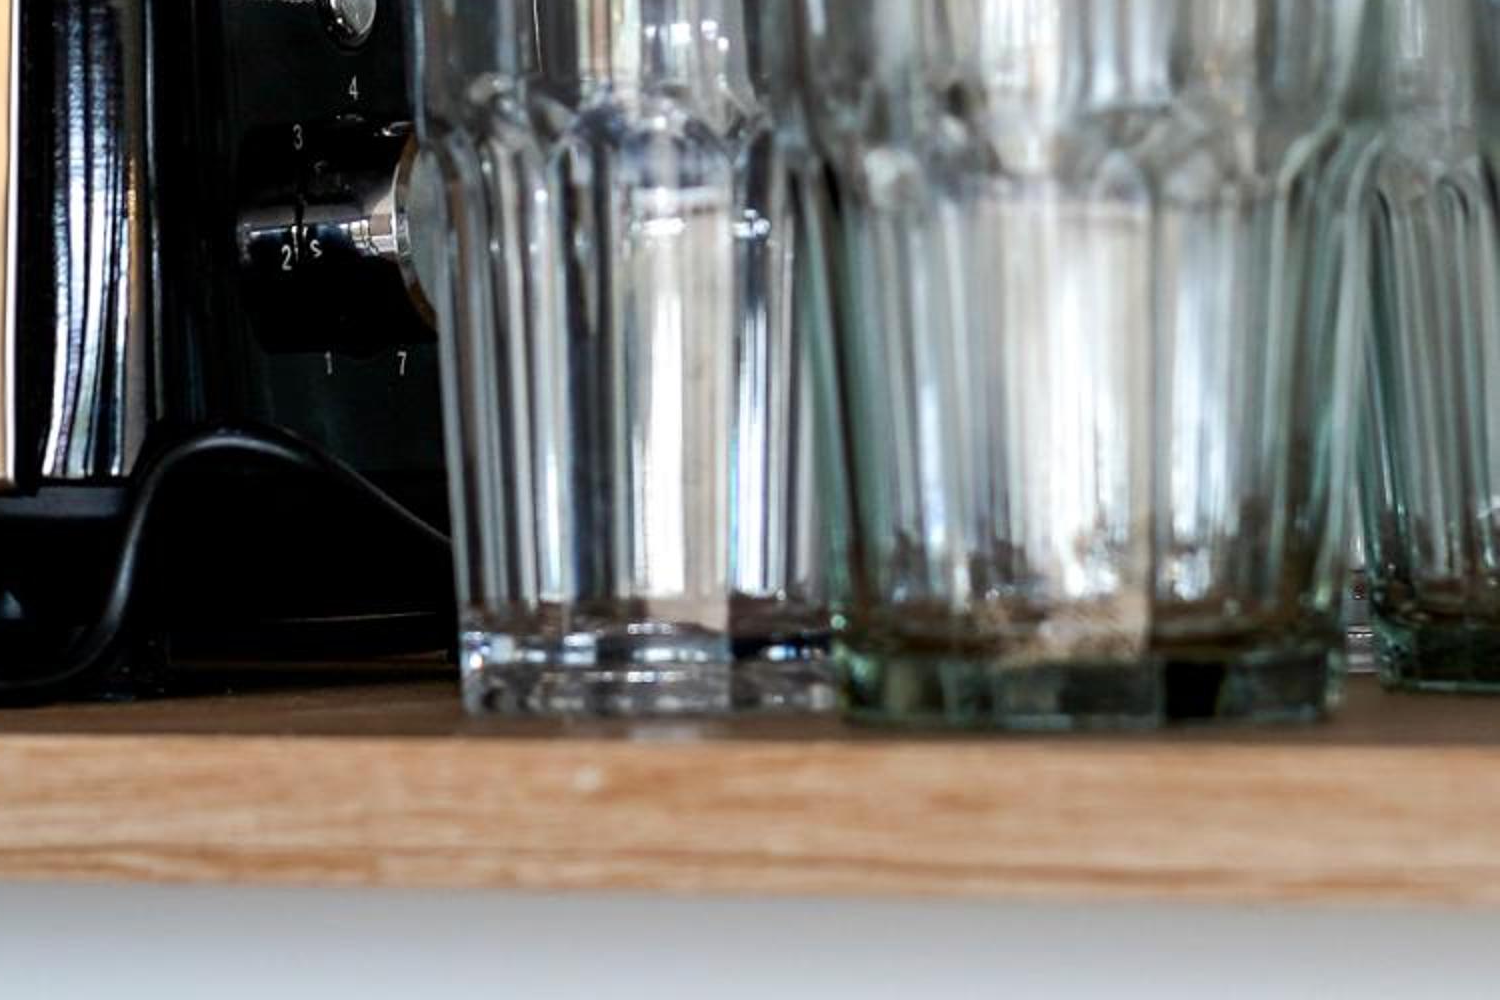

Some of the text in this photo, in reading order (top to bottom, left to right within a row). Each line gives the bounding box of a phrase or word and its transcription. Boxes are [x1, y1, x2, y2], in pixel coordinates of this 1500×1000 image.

[349, 75, 358, 100] 4
[293, 123, 303, 150] 3
[281, 244, 293, 271] 2
[324, 351, 333, 375] 1
[397, 351, 408, 376] 7
